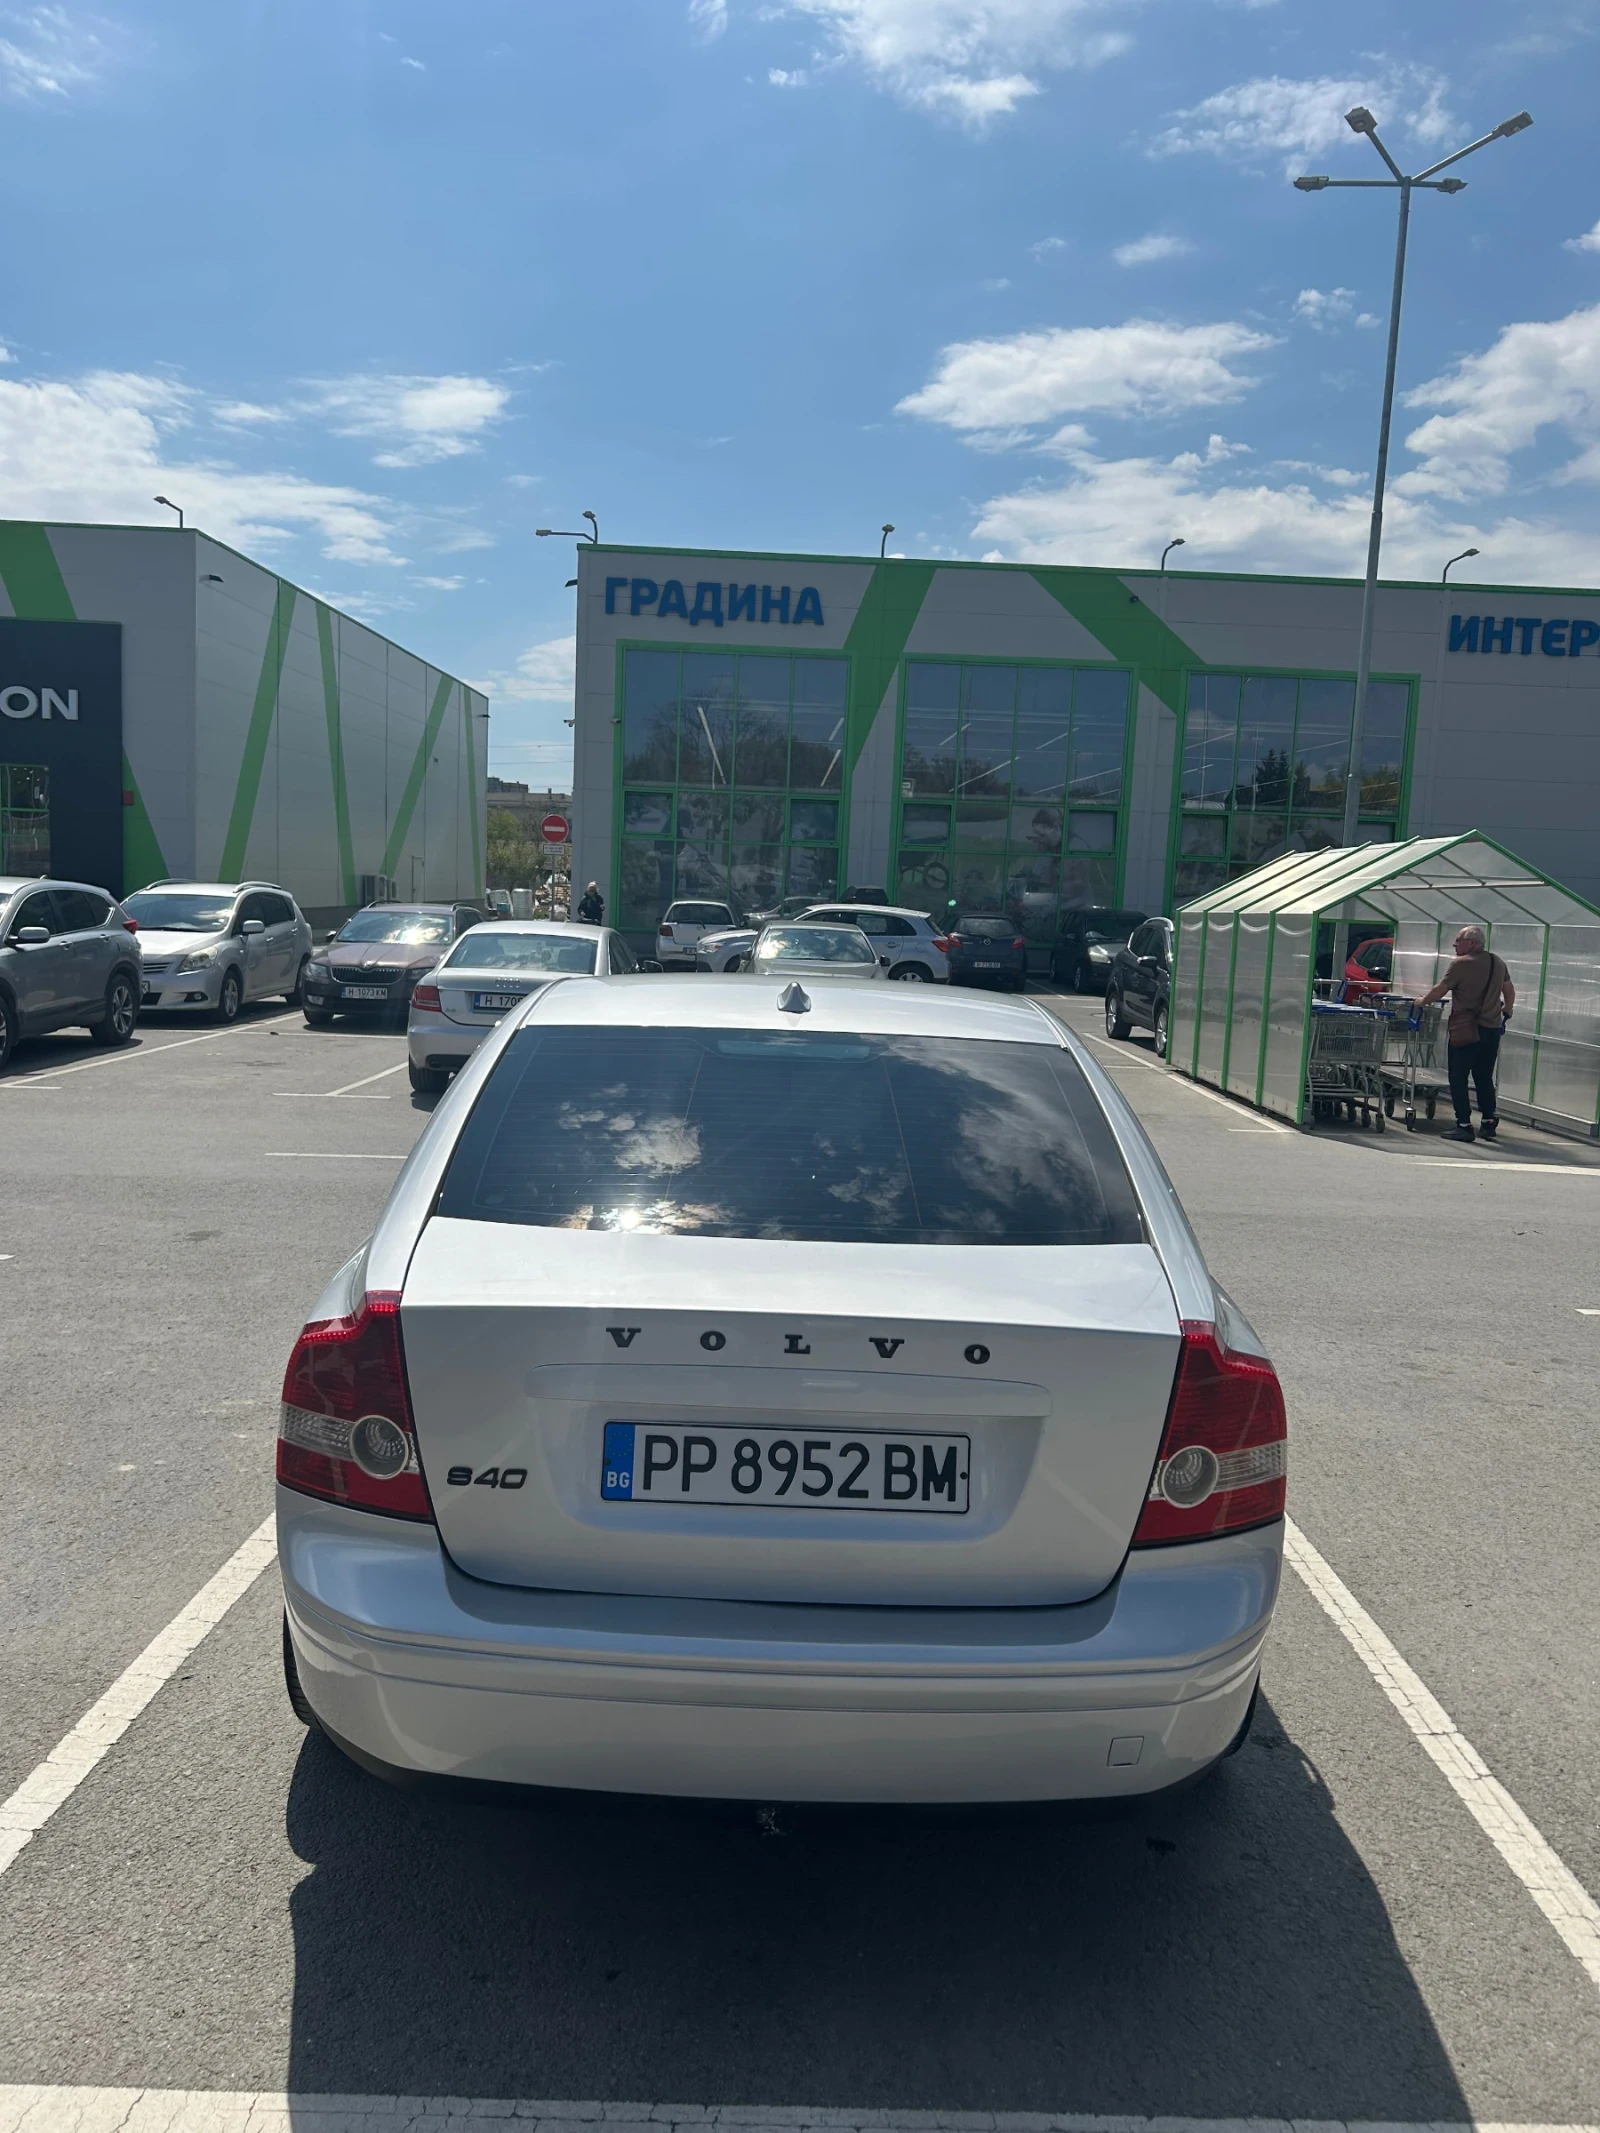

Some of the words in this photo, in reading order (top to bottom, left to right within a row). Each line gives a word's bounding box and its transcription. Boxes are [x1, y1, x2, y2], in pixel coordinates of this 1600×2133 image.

[605, 577, 824, 627] ГРАДИНА
[0, 685, 79, 720] ON
[485, 995, 493, 1006] H
[605, 1327, 990, 1365] VOLVO
[607, 1471, 630, 1488] BG
[643, 1435, 717, 1492] PP
[731, 1438, 870, 1499] 8952
[884, 1443, 957, 1502] BM
